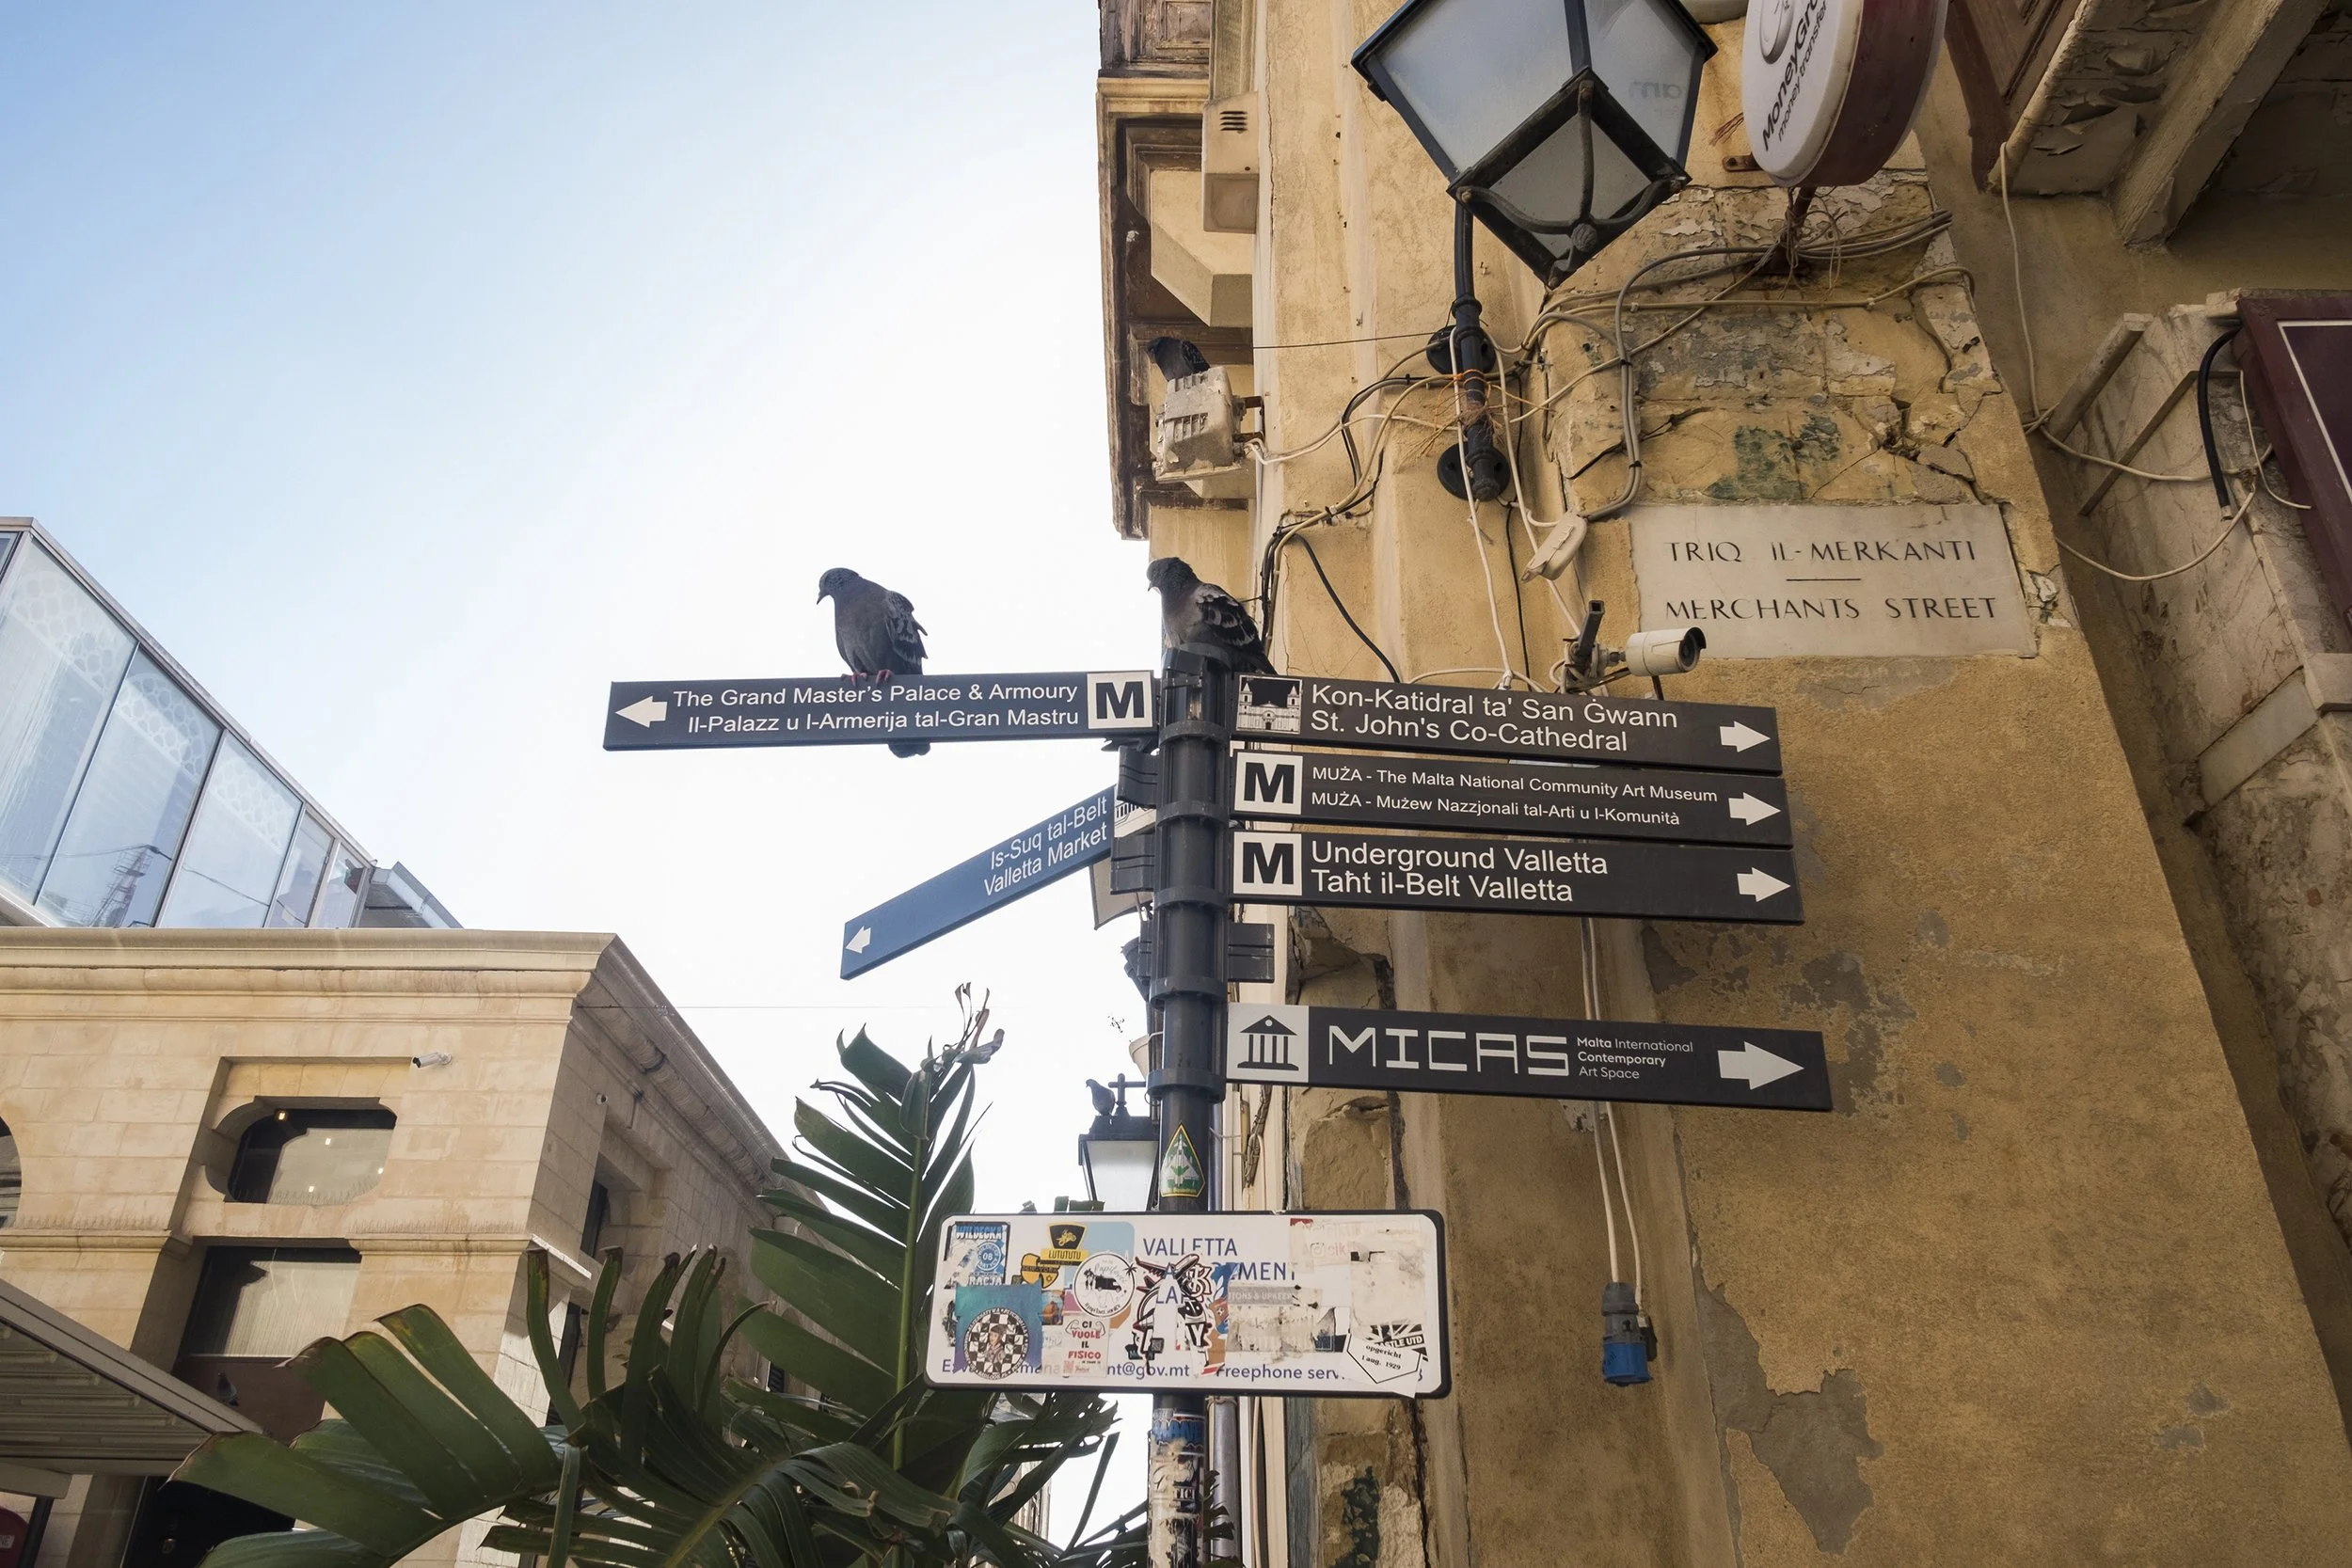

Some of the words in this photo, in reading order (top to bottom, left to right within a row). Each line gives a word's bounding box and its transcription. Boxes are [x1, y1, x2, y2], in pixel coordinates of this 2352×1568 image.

[1778, 76, 1801, 141] money
[1799, 0, 1826, 76] transfer
[1663, 541, 1742, 562] TRIQ
[1665, 597, 1860, 619] MERCHANTS
[1884, 597, 1996, 619] STREET
[674, 690, 713, 706] The
[721, 689, 786, 705] Grand
[793, 686, 882, 704] Master's
[890, 685, 961, 702] Palace
[968, 684, 983, 701] &
[989, 683, 1078, 703] Armoury
[1095, 681, 1145, 720] M
[1311, 684, 1473, 715] Kon-Katidral
[1483, 698, 1512, 717] ta'
[1522, 699, 1574, 721] San
[688, 716, 780, 733] Il-Palazz
[787, 718, 800, 731] u
[806, 711, 907, 732] l-Armerija
[914, 710, 1000, 728] tal-Gran
[1008, 709, 1079, 725] Mastru
[1311, 710, 1345, 733] St.
[1355, 713, 1439, 738] John's
[1450, 720, 1628, 752] Co-Cathedral
[1244, 762, 1295, 804] M
[1376, 769, 1406, 784] The
[1412, 772, 1454, 786] Malta
[1460, 774, 1524, 790] National
[1529, 778, 1618, 798] Community
[1622, 785, 1645, 798] Art
[1650, 785, 1718, 802] Museum
[1438, 800, 1518, 816] Nazzjonali
[1524, 803, 1575, 819] tal-Arti
[1580, 810, 1590, 820] u
[1595, 808, 1680, 826] l-Komunità
[991, 832, 1041, 870] Is-Suq
[1047, 796, 1107, 843] tal-Belt
[983, 856, 1041, 895] Valletta
[1047, 821, 1107, 867] Market
[1242, 842, 1295, 885] M
[1311, 840, 1495, 872] Underground
[1504, 847, 1608, 875] Valletta
[1381, 871, 1461, 896] il-Belt
[1469, 875, 1573, 901] Valletta
[1328, 1024, 1569, 1076] MICAS
[1577, 1037, 1612, 1048] Malta
[1614, 1038, 1693, 1053] International
[1578, 1051, 1666, 1068] Contemporary
[1579, 1066, 1597, 1077] Art
[1600, 1067, 1640, 1080] Space
[1072, 1330, 1101, 1339] VUOLE
[1068, 1351, 1102, 1359] FISICO
[1365, 1344, 1402, 1359] opgericht
[1366, 1357, 1381, 1366] aug.
[1385, 1361, 1401, 1370] 1929
